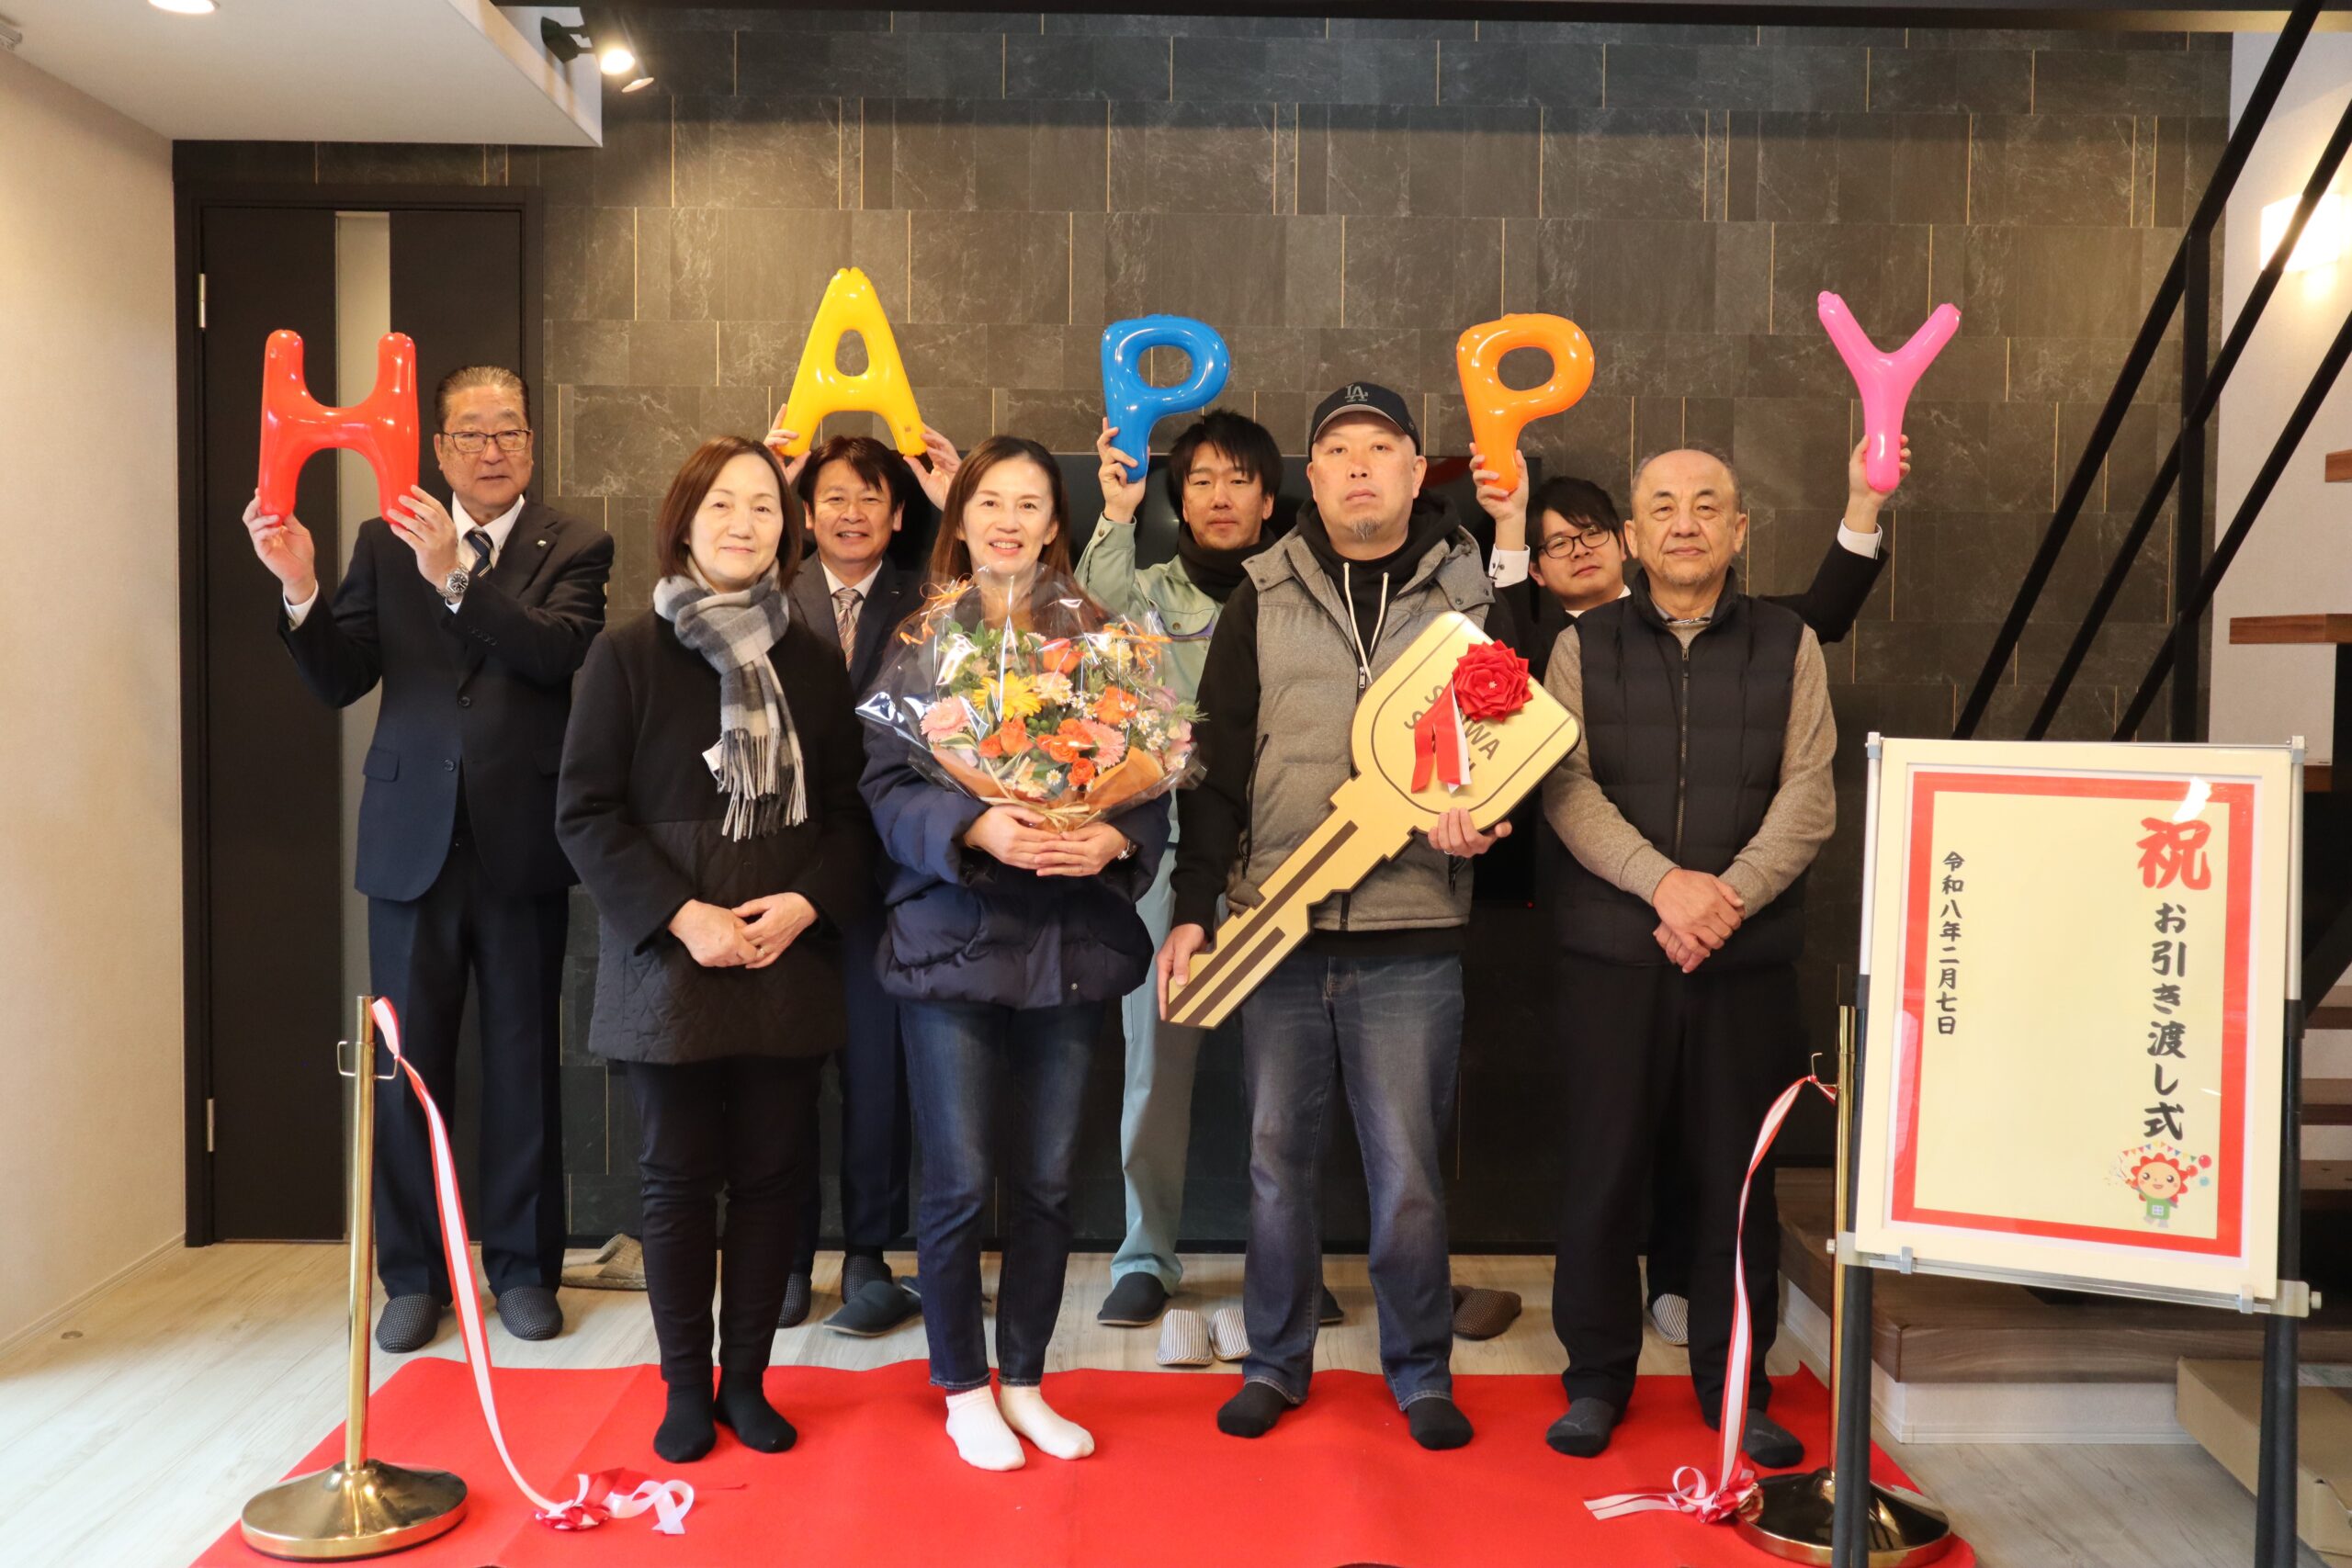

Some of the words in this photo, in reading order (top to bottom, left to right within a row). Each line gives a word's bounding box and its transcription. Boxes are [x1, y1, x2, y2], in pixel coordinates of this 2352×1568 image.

[1345, 384, 1369, 402] LA
[2137, 818, 2211, 891] 祝
[1936, 851, 1965, 1036] 令和八年二月七日
[2143, 902, 2188, 1141] お引き渡し式
